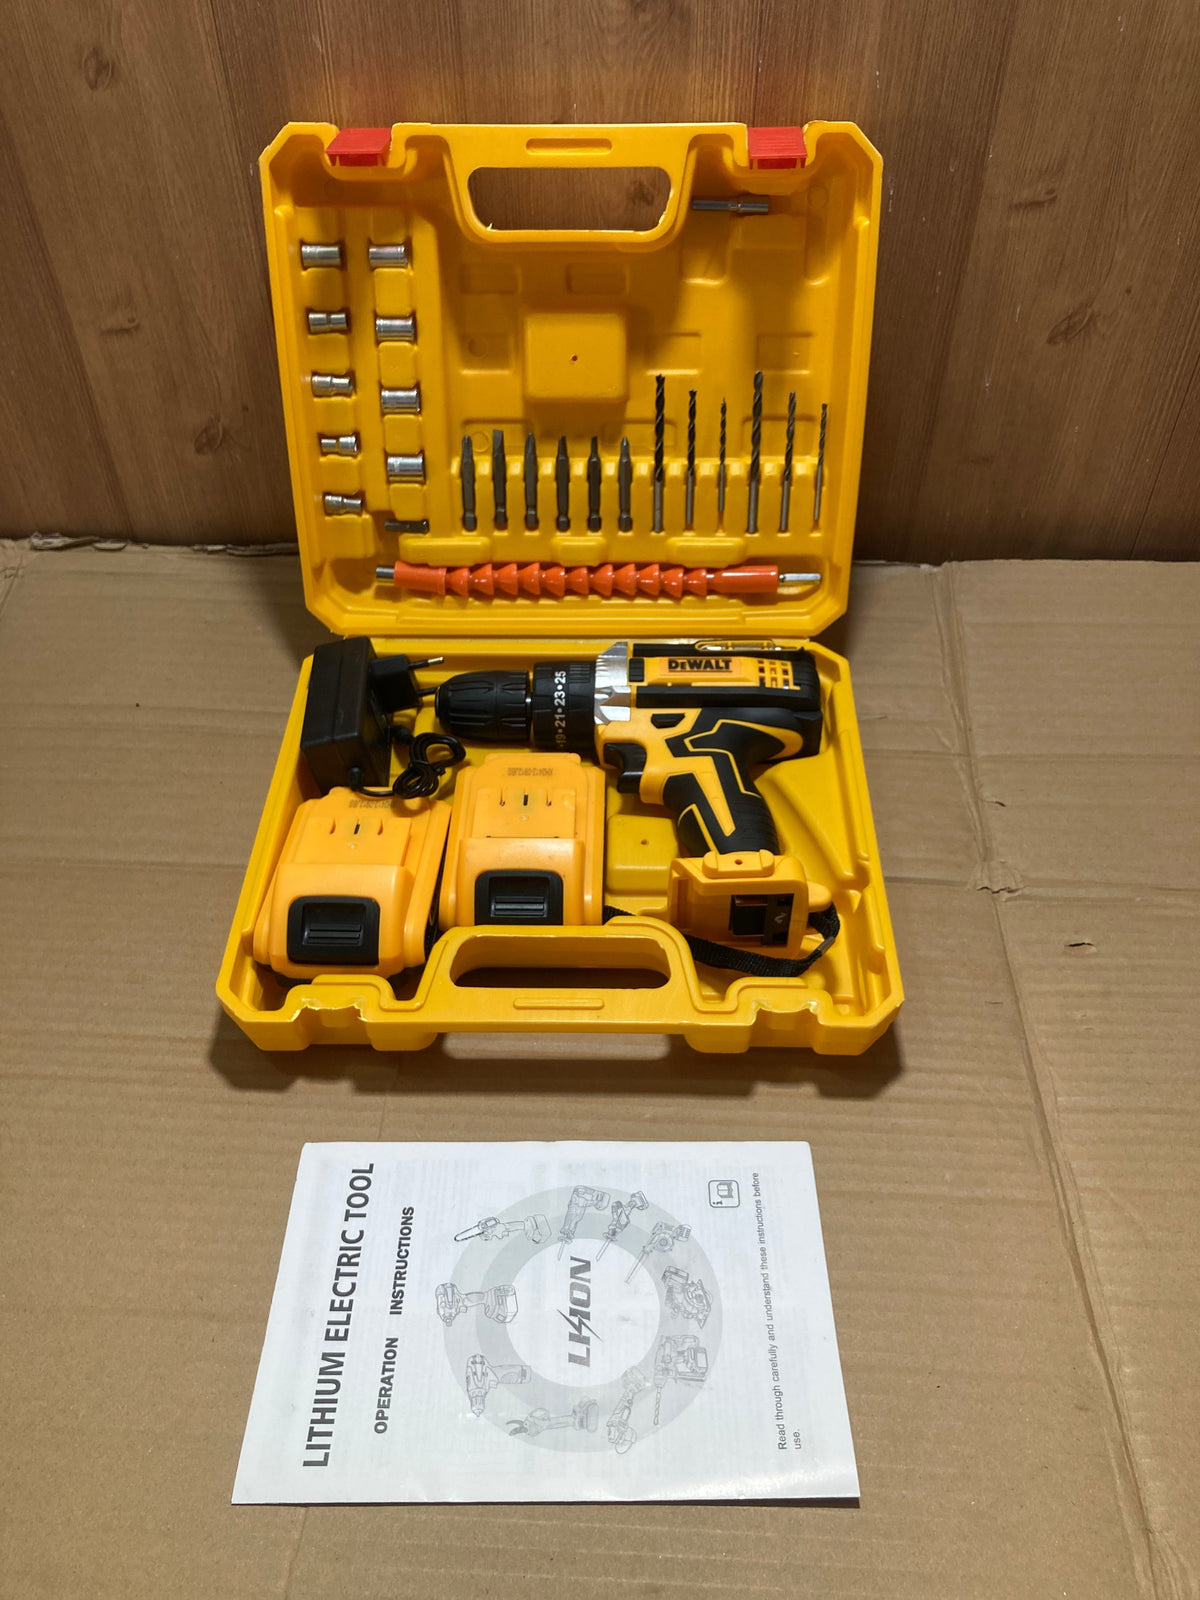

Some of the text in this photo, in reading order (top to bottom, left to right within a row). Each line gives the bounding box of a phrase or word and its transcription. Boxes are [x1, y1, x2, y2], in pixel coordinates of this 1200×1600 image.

[302, 1163, 374, 1467] LITHIUM ELECTRIC TOOL
[373, 1206, 414, 1434] OPERATION INSTRUCTIONS
[751, 1172, 787, 1450] Read through carefully and understand these instructions before
